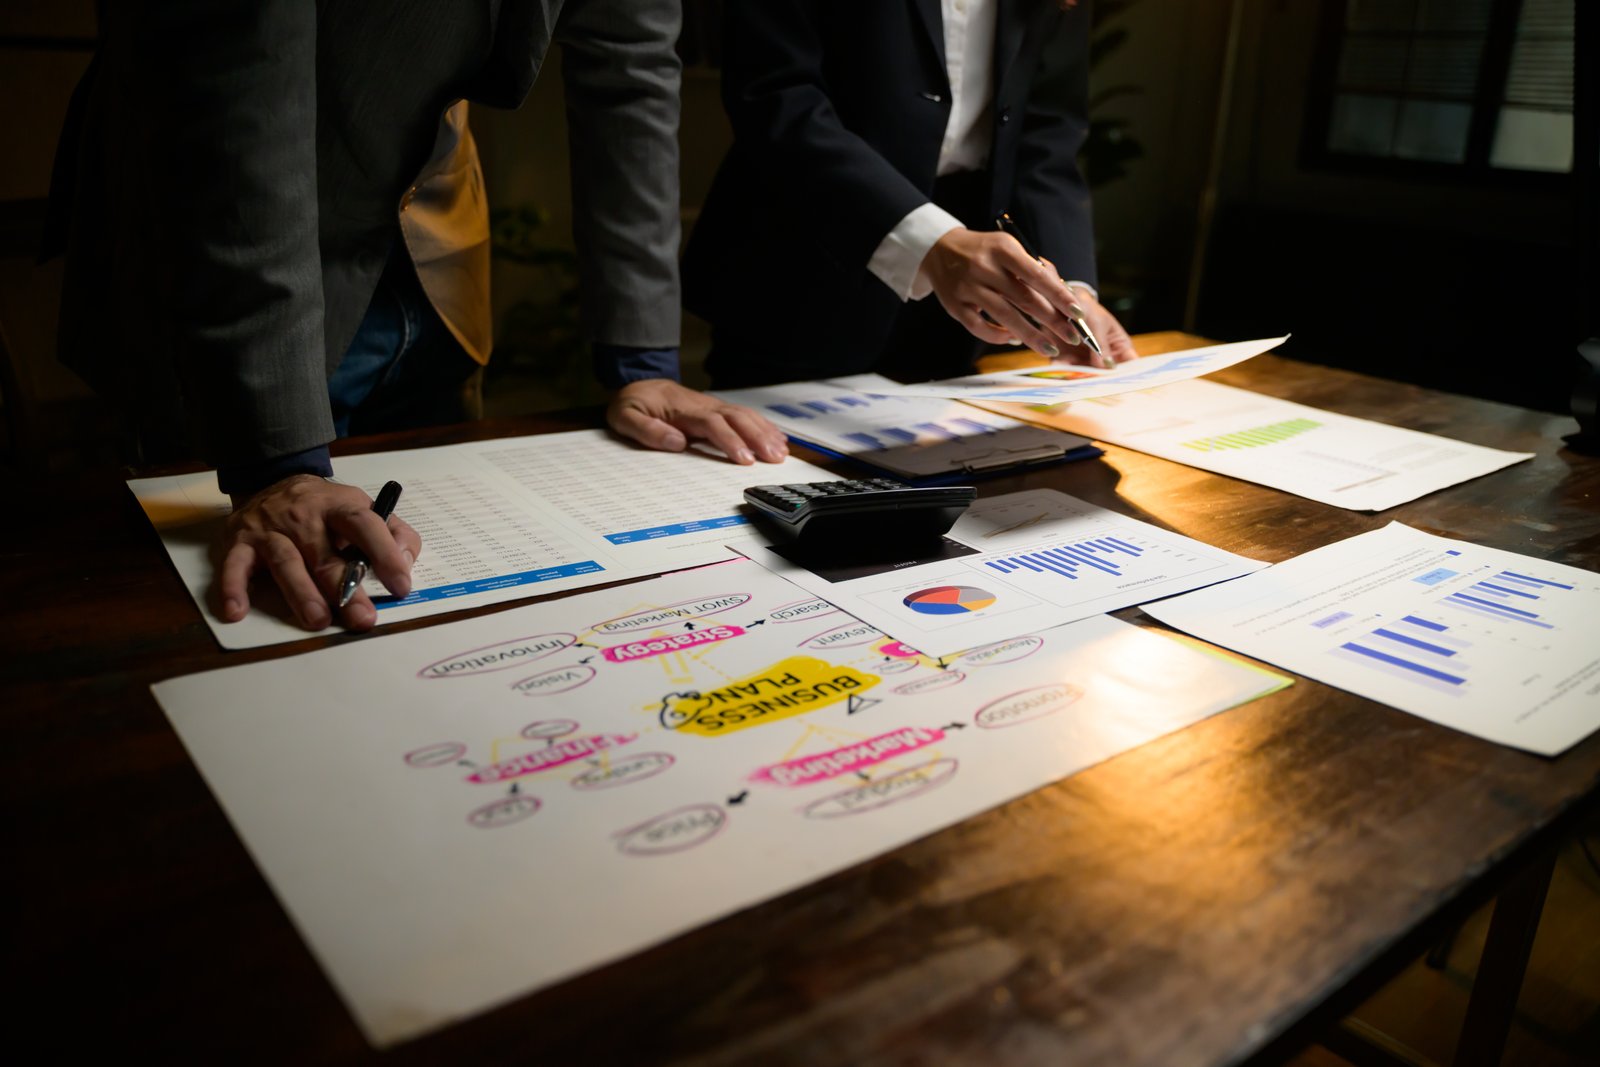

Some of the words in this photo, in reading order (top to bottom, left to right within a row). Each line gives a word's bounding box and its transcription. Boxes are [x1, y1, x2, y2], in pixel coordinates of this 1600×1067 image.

[604, 607, 689, 631] Marketing
[699, 596, 743, 613] SWOT
[770, 601, 830, 620] search
[613, 626, 735, 660] Strategy
[814, 624, 876, 645] levant
[431, 639, 567, 676] Innovation
[514, 671, 582, 691] Vision
[708, 672, 801, 704] PLAN
[696, 675, 862, 730] BUSINESS
[475, 734, 612, 779] Finance
[769, 727, 935, 786] Marketing
